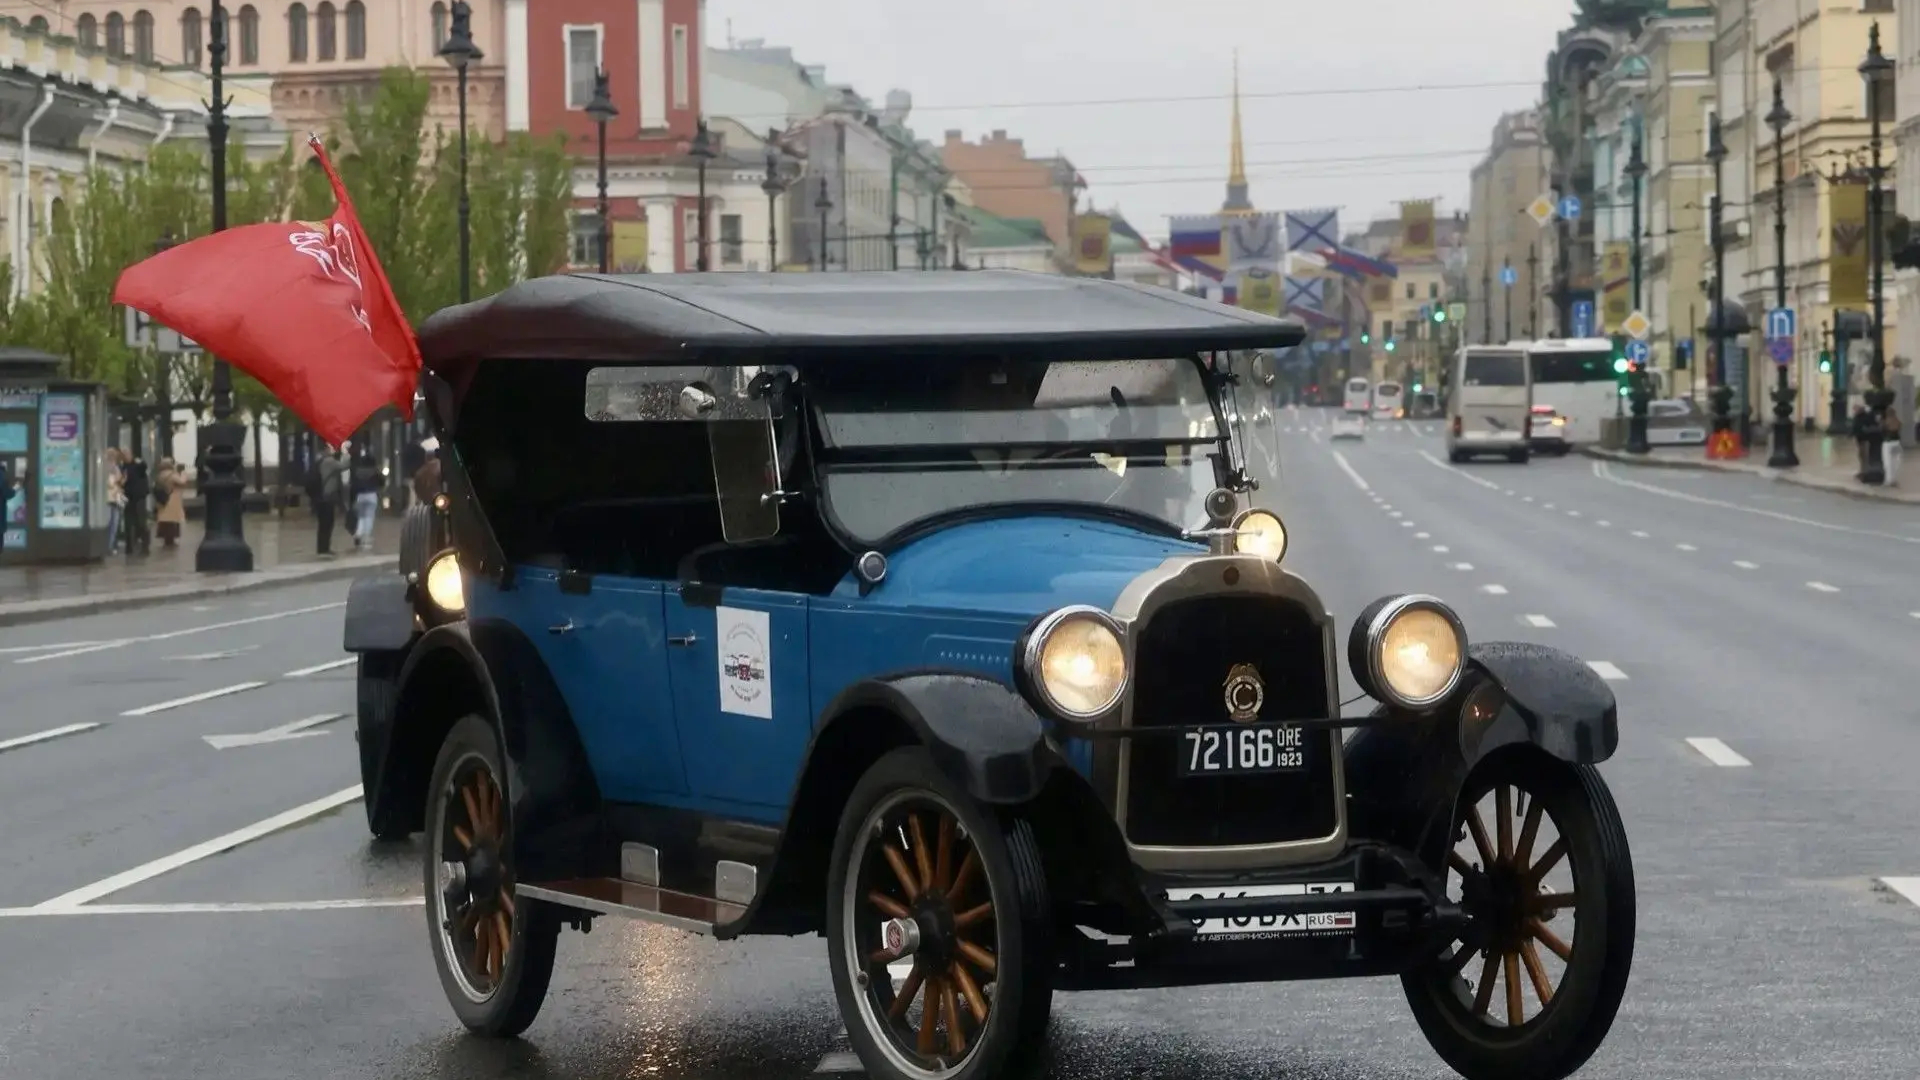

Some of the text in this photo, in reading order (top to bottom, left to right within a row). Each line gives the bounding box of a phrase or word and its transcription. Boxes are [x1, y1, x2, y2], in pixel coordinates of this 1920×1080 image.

[1277, 727, 1303, 746] ORE
[1185, 729, 1274, 770] 72166
[1277, 752, 1303, 767] 1923
[1308, 914, 1334, 926] RUS
